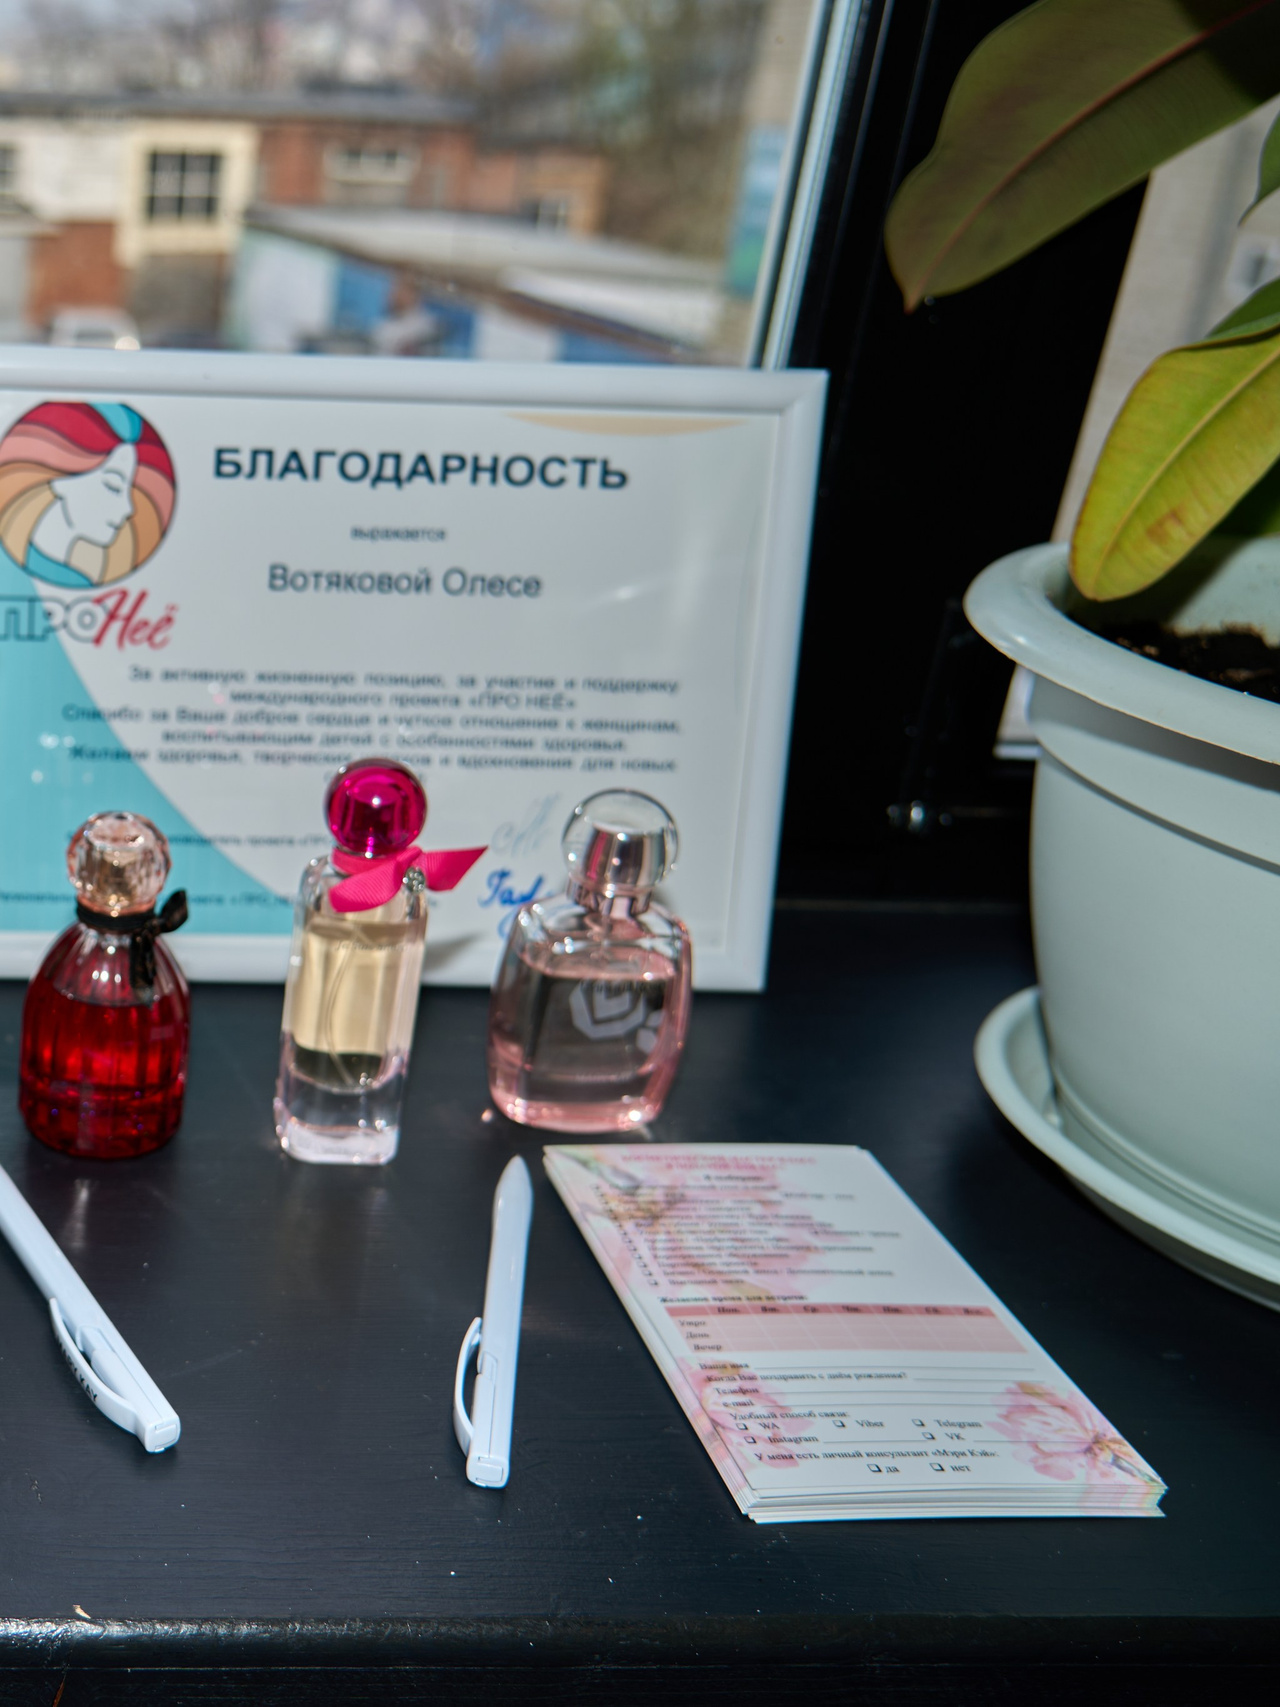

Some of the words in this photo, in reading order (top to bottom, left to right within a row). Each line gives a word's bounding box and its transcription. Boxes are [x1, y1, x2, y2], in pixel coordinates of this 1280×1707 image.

[212, 446, 630, 491] БЛАГОДАРНОСТЬ
[350, 526, 447, 543] выражается
[266, 562, 432, 595] Вотяковой
[440, 567, 543, 599] Олесе
[79, 1373, 98, 1403] KAY
[713, 1386, 760, 1396] Телефон
[722, 1398, 755, 1407] e-mail
[729, 1411, 778, 1421] Удобный
[779, 1410, 817, 1419] способ
[818, 1410, 849, 1419] связи:
[758, 1422, 781, 1431] WA
[854, 1419, 886, 1428] Viber
[933, 1418, 983, 1429] Telegram
[767, 1435, 820, 1446] Instagram
[944, 1432, 966, 1441] VK
[766, 1452, 795, 1461] меня
[796, 1451, 820, 1460] есть
[822, 1450, 864, 1460] личный
[864, 1450, 930, 1459] консультант
[930, 1449, 968, 1460] «Мэри
[884, 1465, 900, 1473] да
[949, 1463, 972, 1473] нет
